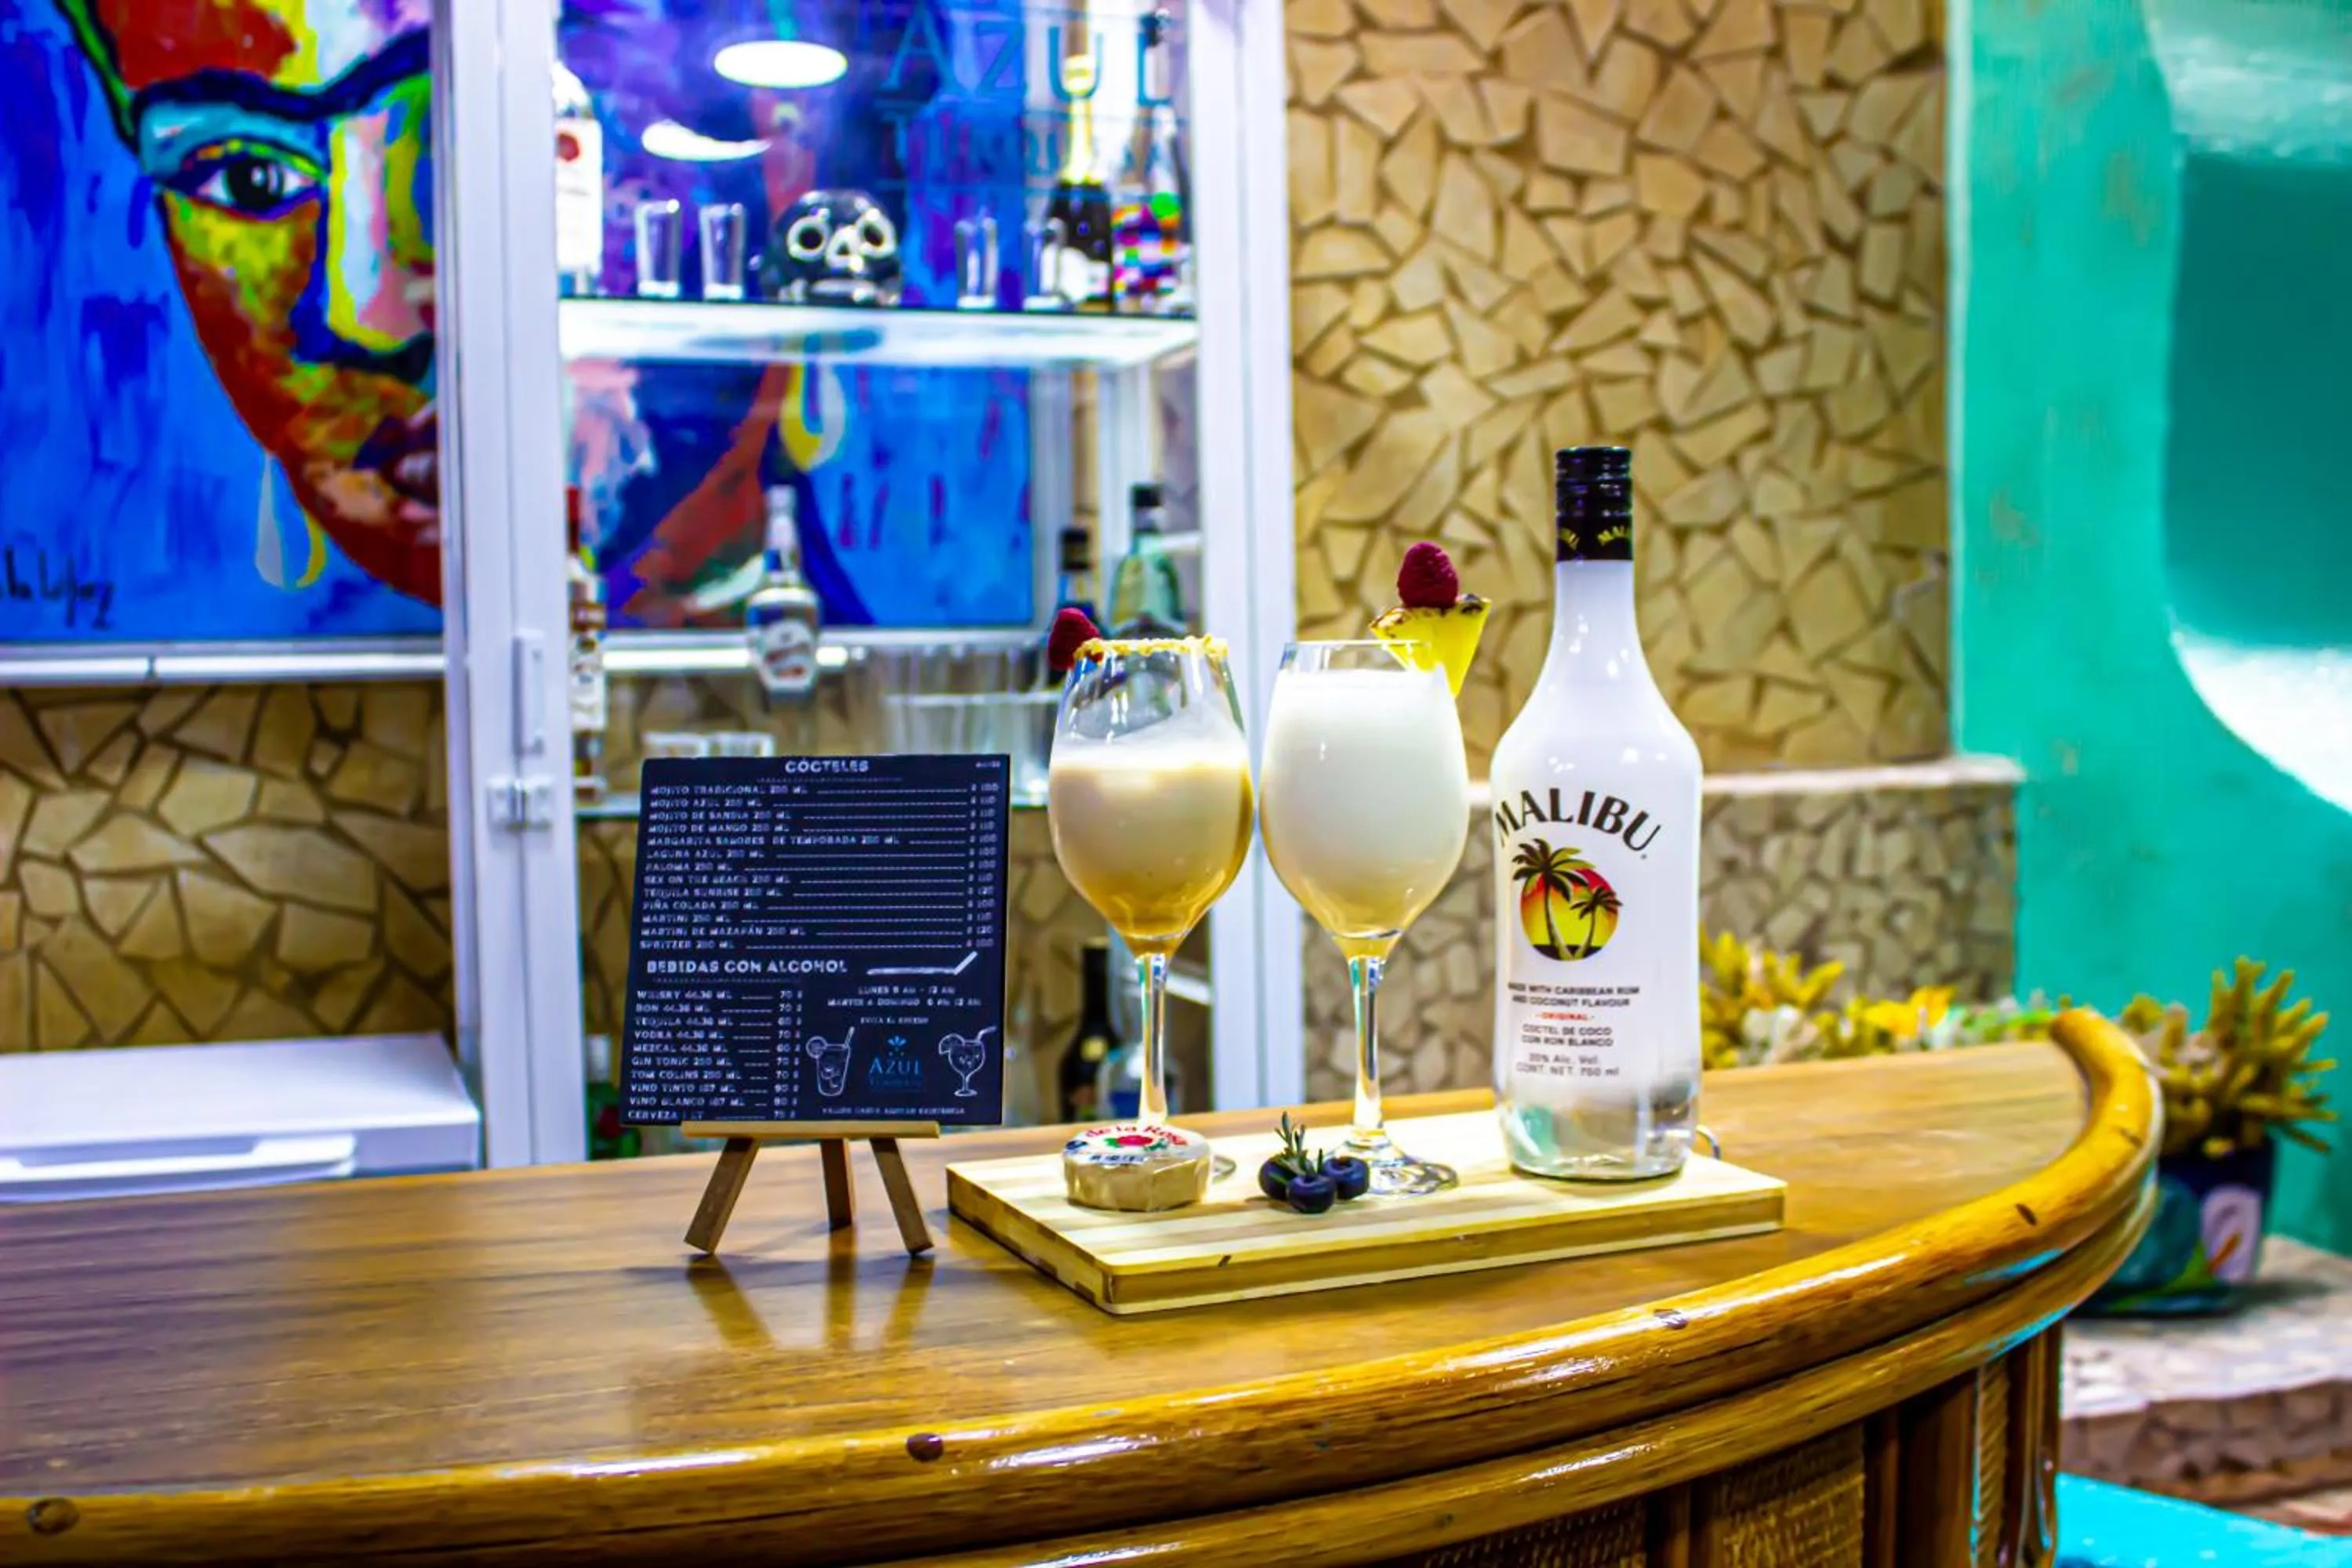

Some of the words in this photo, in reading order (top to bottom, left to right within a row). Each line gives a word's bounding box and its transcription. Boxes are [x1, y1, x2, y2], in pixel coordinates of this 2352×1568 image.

[1496, 788, 1661, 851] MALIBU
[647, 960, 719, 974] BEBIDAS
[724, 960, 762, 974] CON
